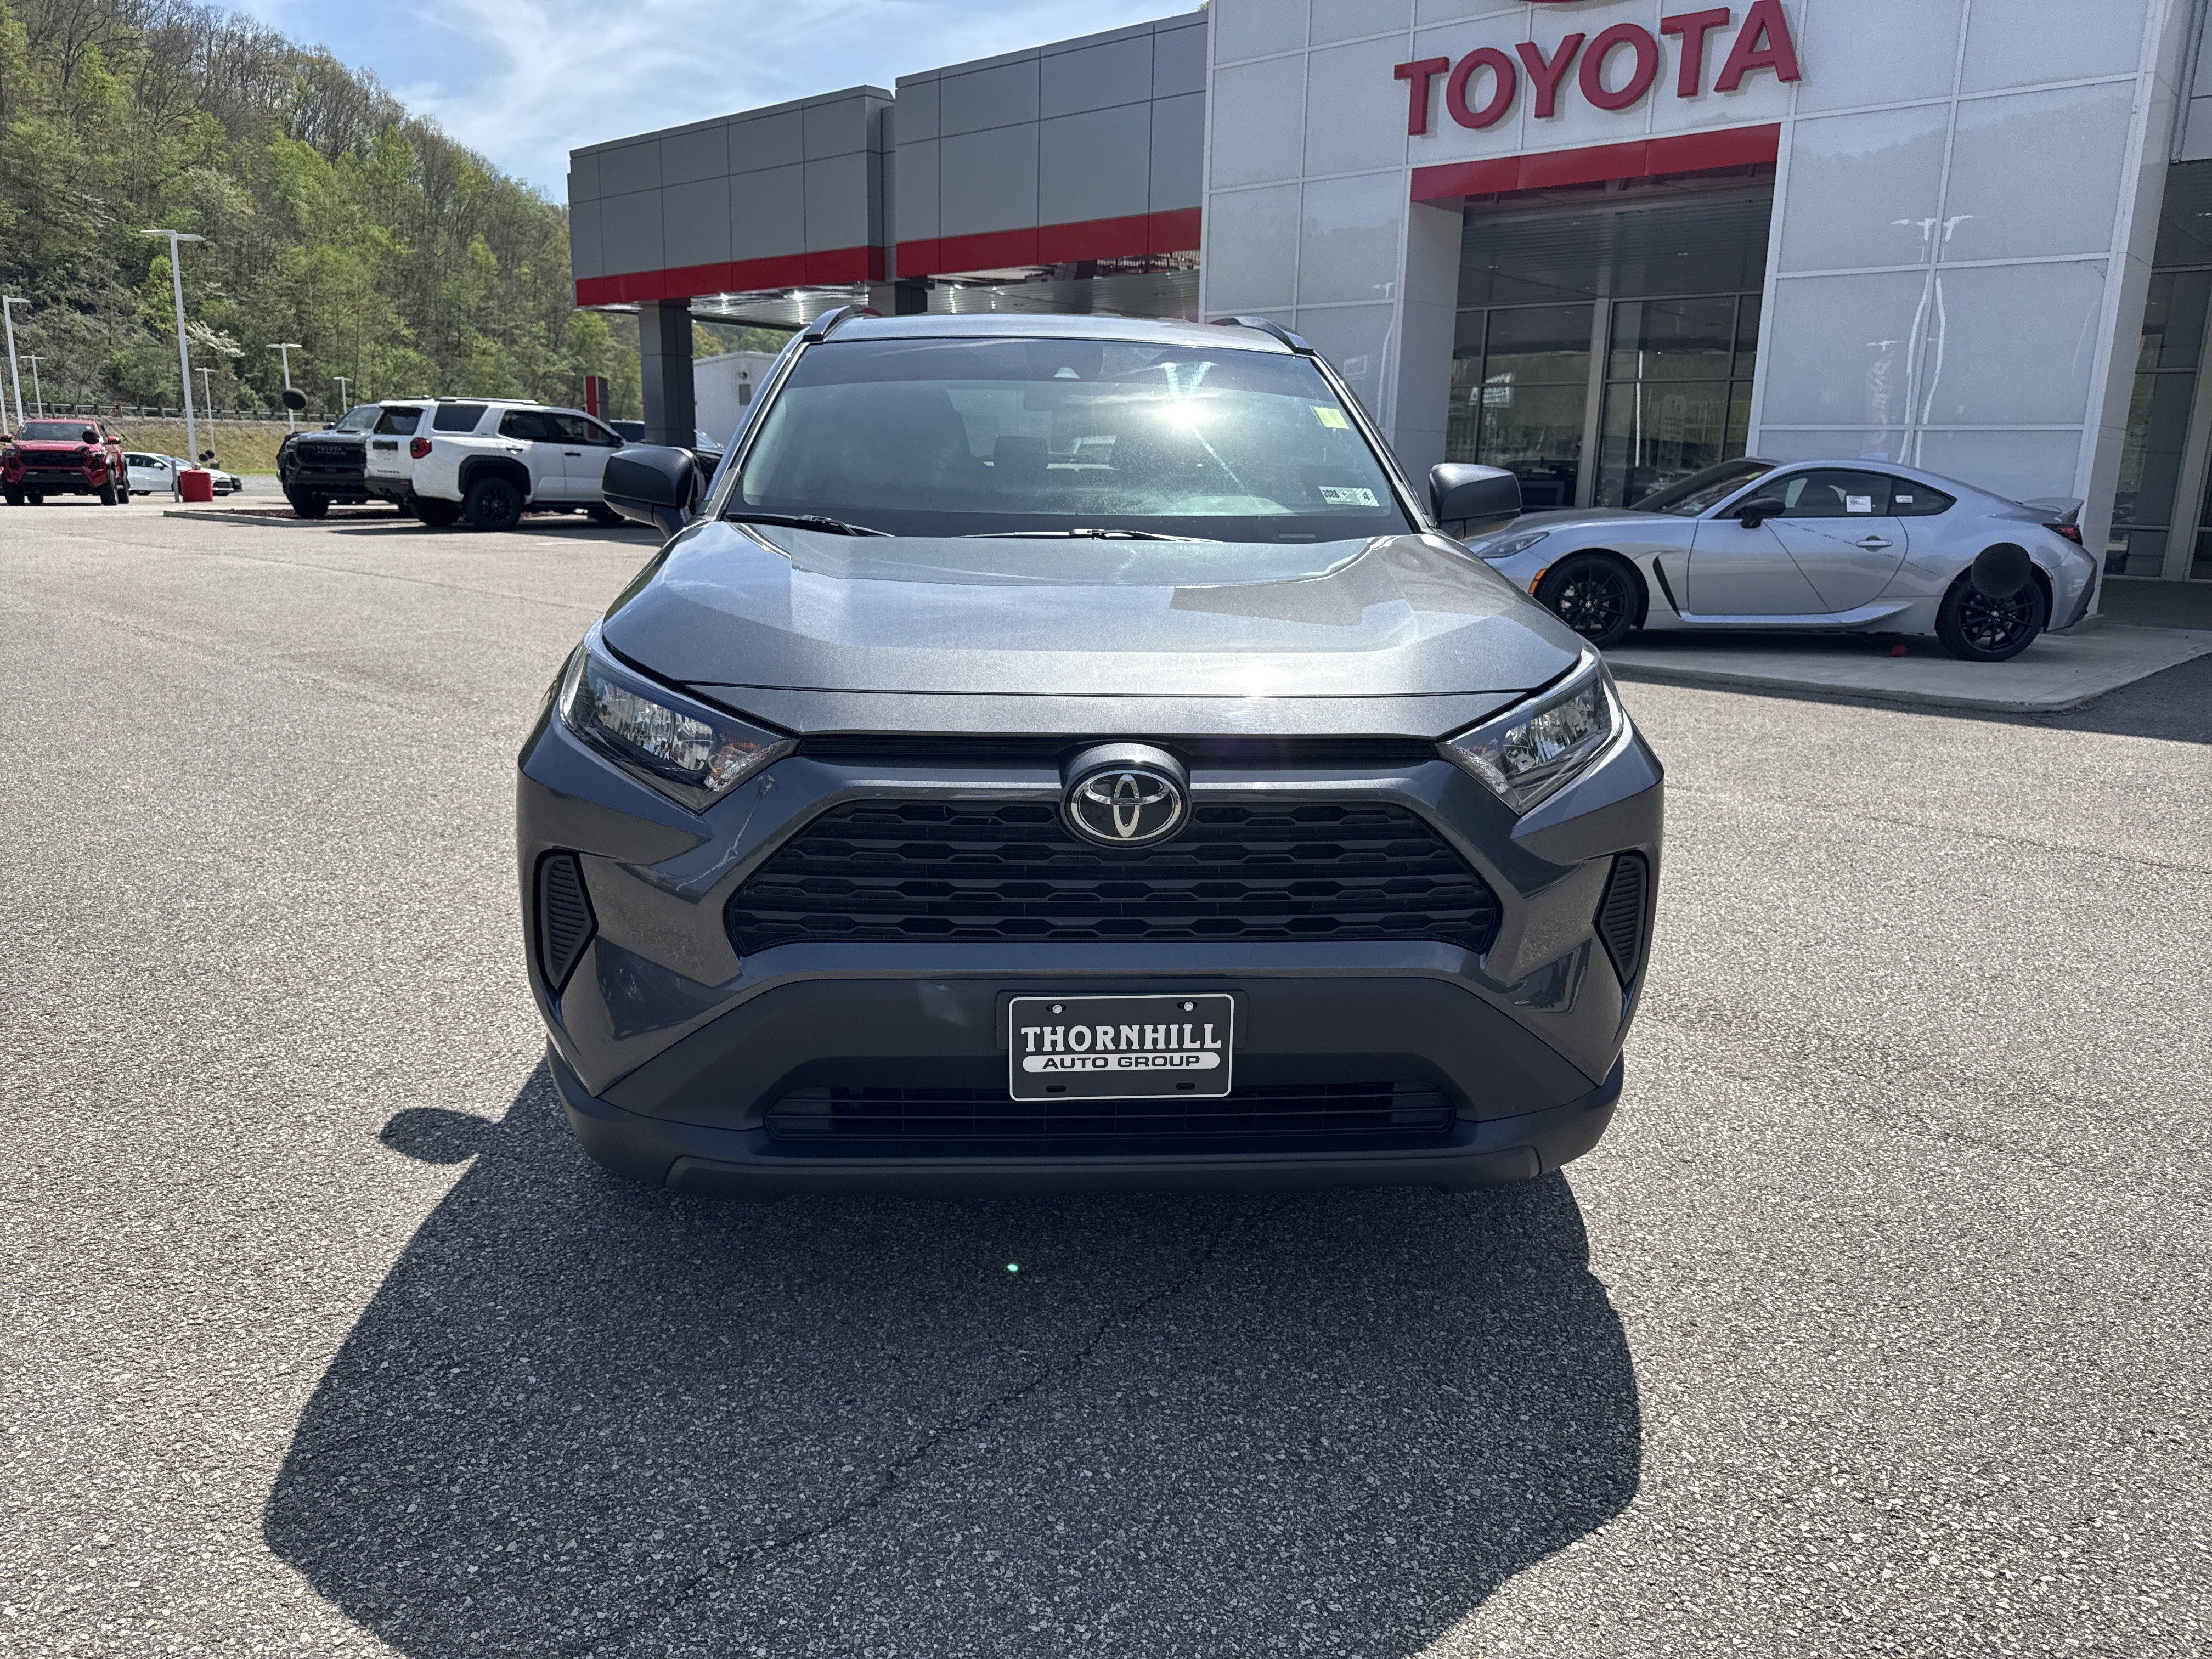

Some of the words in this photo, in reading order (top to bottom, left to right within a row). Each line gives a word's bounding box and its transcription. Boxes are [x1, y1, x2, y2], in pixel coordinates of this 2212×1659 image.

[1393, 0, 1802, 136] TOYOTA
[1020, 1023, 1222, 1052] THORNHILL
[1042, 1057, 1109, 1069] AUTO
[1117, 1055, 1200, 1068] GROUP
